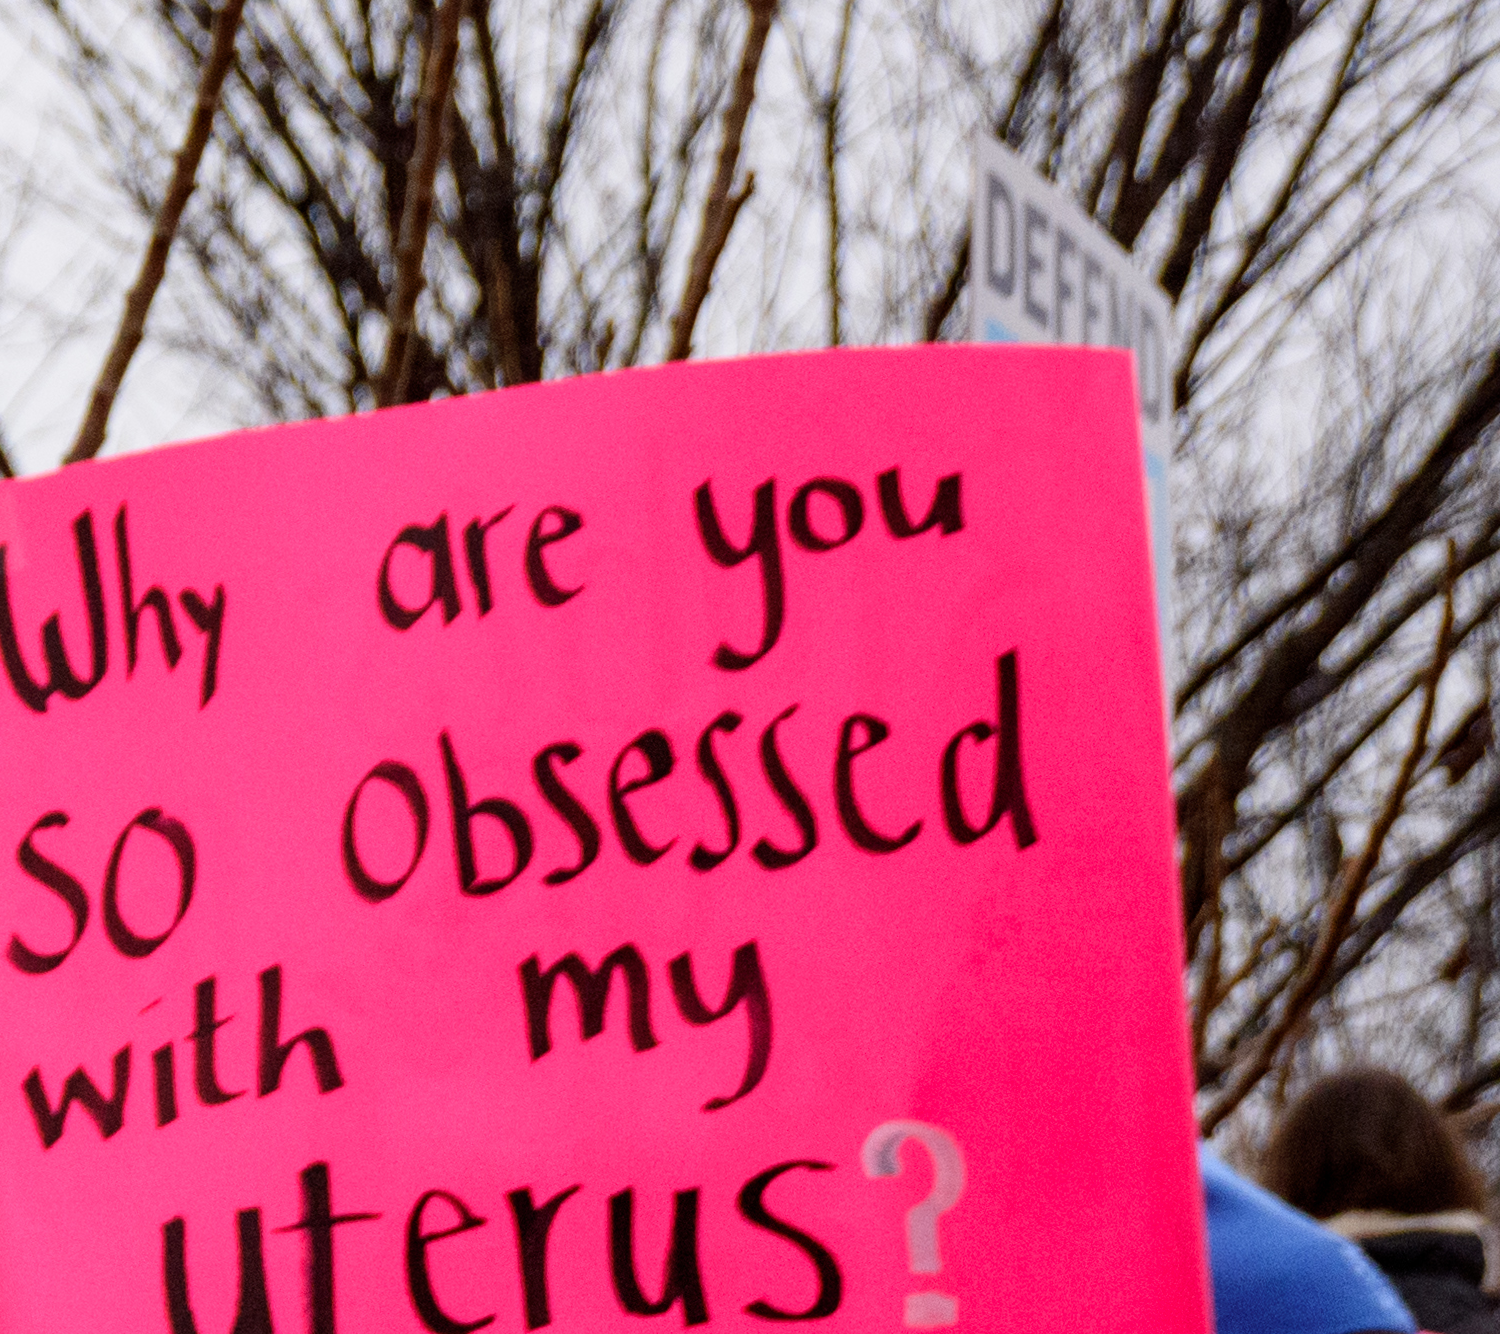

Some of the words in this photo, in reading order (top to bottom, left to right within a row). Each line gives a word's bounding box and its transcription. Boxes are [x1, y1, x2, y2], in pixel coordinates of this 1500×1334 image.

[378, 505, 584, 630] are
[695, 469, 964, 671] you
[341, 650, 1039, 903] obsessed
[23, 965, 344, 1149] with
[519, 942, 773, 1111] my
